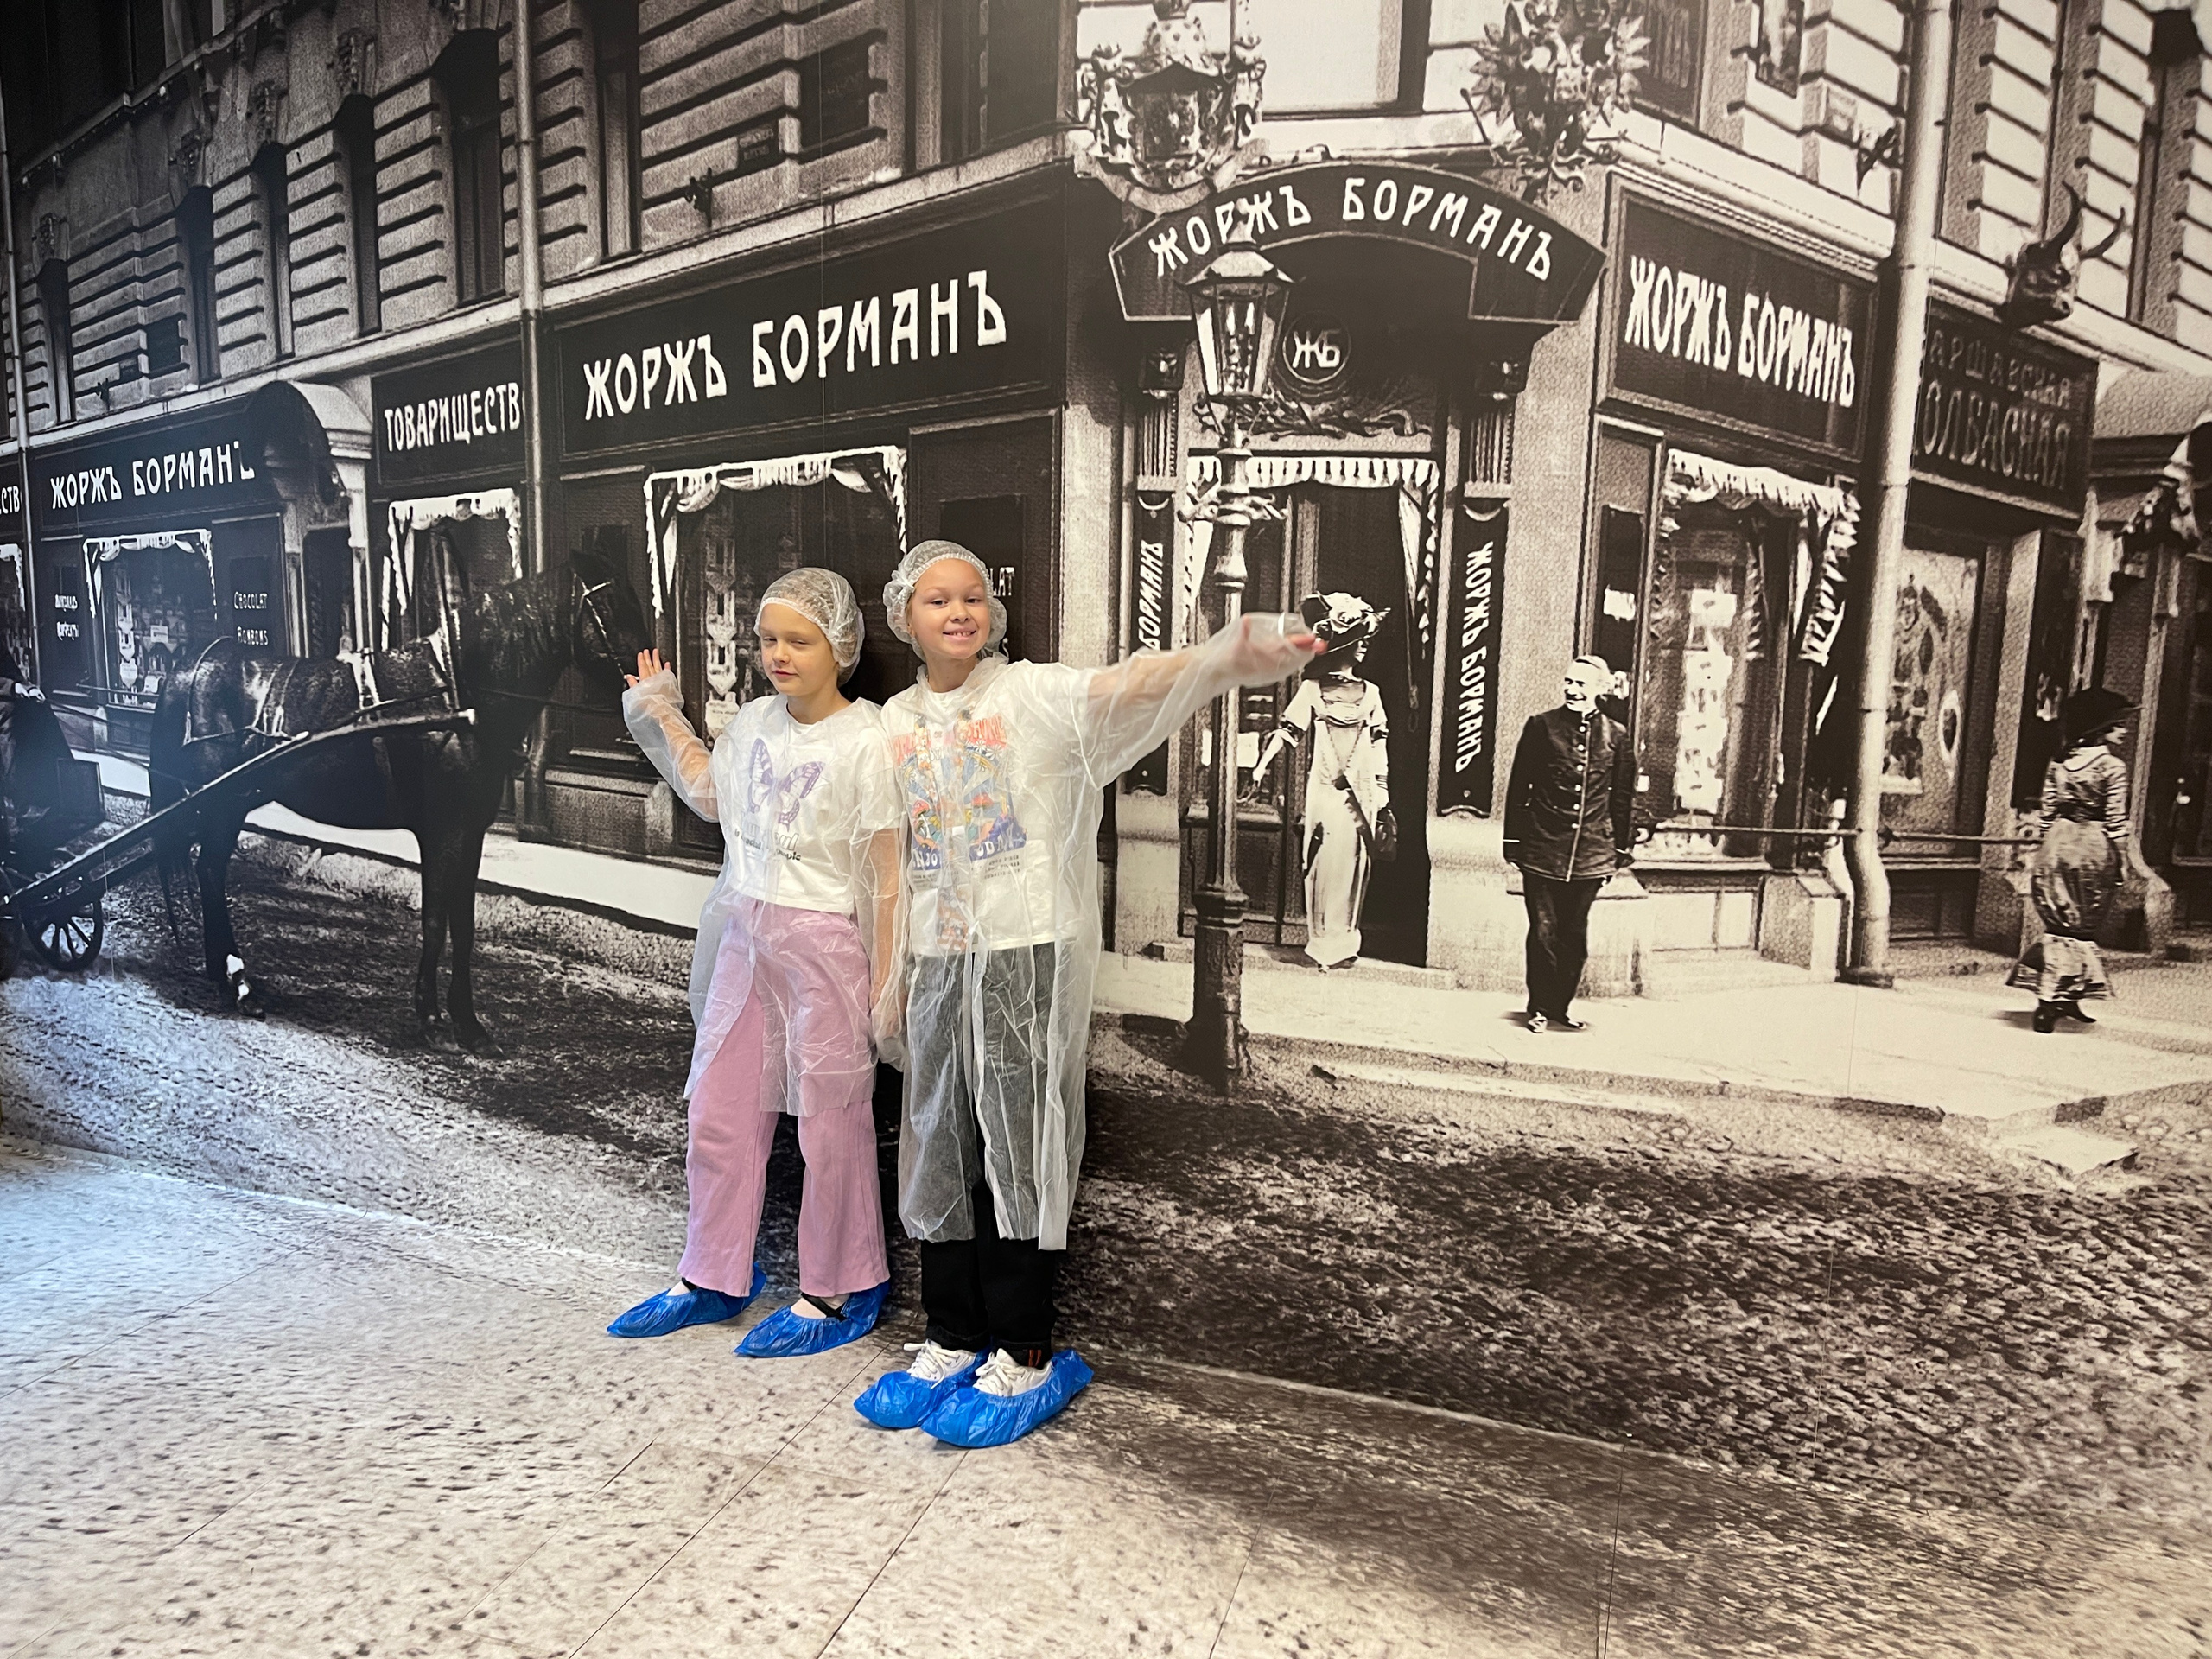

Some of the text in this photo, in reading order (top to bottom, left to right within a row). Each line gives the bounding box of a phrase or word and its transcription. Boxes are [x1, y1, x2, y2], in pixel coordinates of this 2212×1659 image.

[1148, 177, 1553, 281] ЖОРЖЪ БОРМАНЪ
[583, 270, 1007, 421] ЖОРЖЪ БОРМАНЪ
[1624, 255, 1856, 408] ЖОРЖЪ БОРМАНЪ
[1929, 329, 2072, 410] АРШАВСКАЯ
[385, 382, 525, 452] ТОВАРИЩЕСТВ
[1913, 378, 2072, 491] ОЛБАСНАЯ
[50, 466, 123, 510] ЖОРЖЪ
[1138, 539, 1164, 652] БОРМАНЪ
[1455, 541, 1494, 772] ЖОРЖЪ БОРМАНЪ
